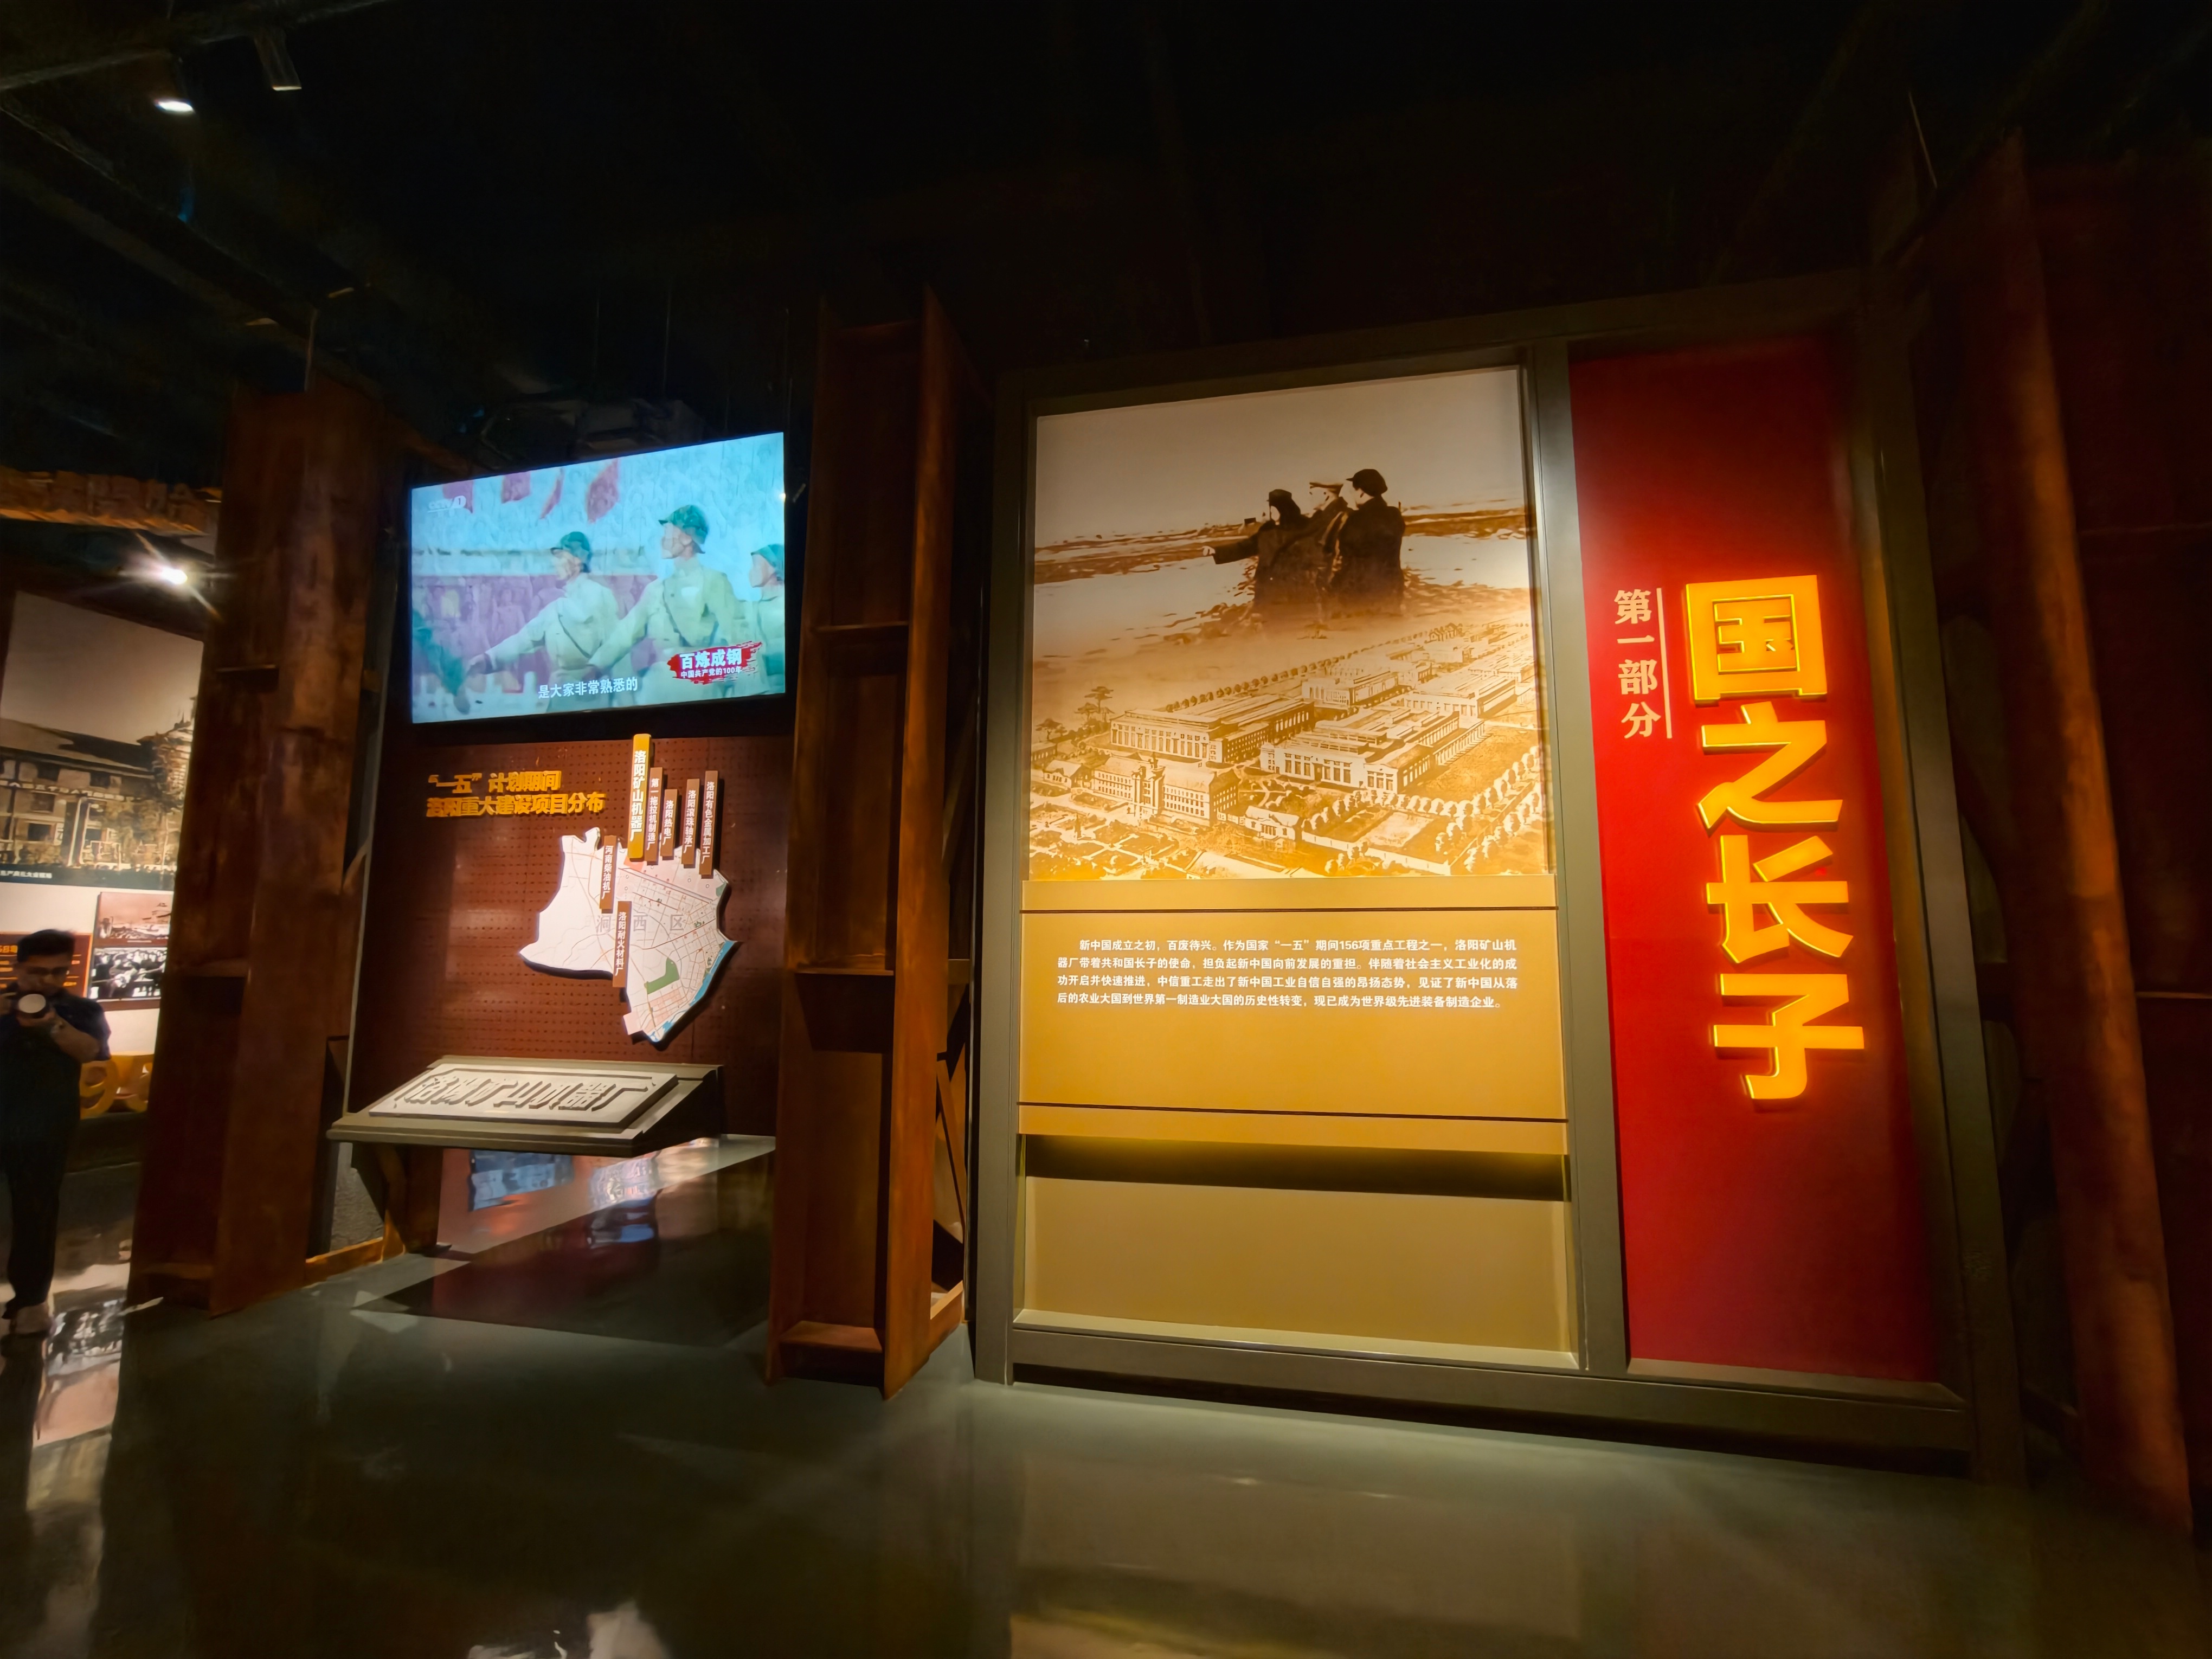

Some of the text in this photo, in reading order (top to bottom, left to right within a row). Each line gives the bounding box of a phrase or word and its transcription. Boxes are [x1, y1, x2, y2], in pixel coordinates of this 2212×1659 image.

[680, 648, 743, 669] 百炼成钢
[680, 666, 742, 679] 中国共产党的100年
[1613, 588, 1661, 739] 第一部分
[538, 677, 638, 699] 是大家非常熟悉的
[426, 791, 607, 818] 洛阳重大建设项目分布
[630, 750, 647, 841] 洛阳矿山机器厂
[647, 778, 660, 850] 第一拖拉机制造厂
[663, 800, 674, 845] 洛阳热电厂
[684, 790, 697, 853] 洛阳滚珠轴承厂
[702, 781, 715, 864] 洛阳有色金属加工厂
[1684, 575, 1865, 1101] 国之长子
[601, 845, 614, 899] 河南柴油机厂
[615, 911, 627, 976] 洛阳耐火材料厂
[1057, 957, 1517, 970] 器厂带着共和国长子的使命，担负起新中国向前发展的重担。伴随着社会主义工业化的成
[1057, 975, 1518, 989] 功开启并快速推进，中信重工走出了新中国工业自信自强的昂扬态势，见证了新中国从落
[1057, 993, 1500, 1008] 后的农业大国到世界第一制造业大国的历史性转变，现已成为世界级先进装备制造企业。
